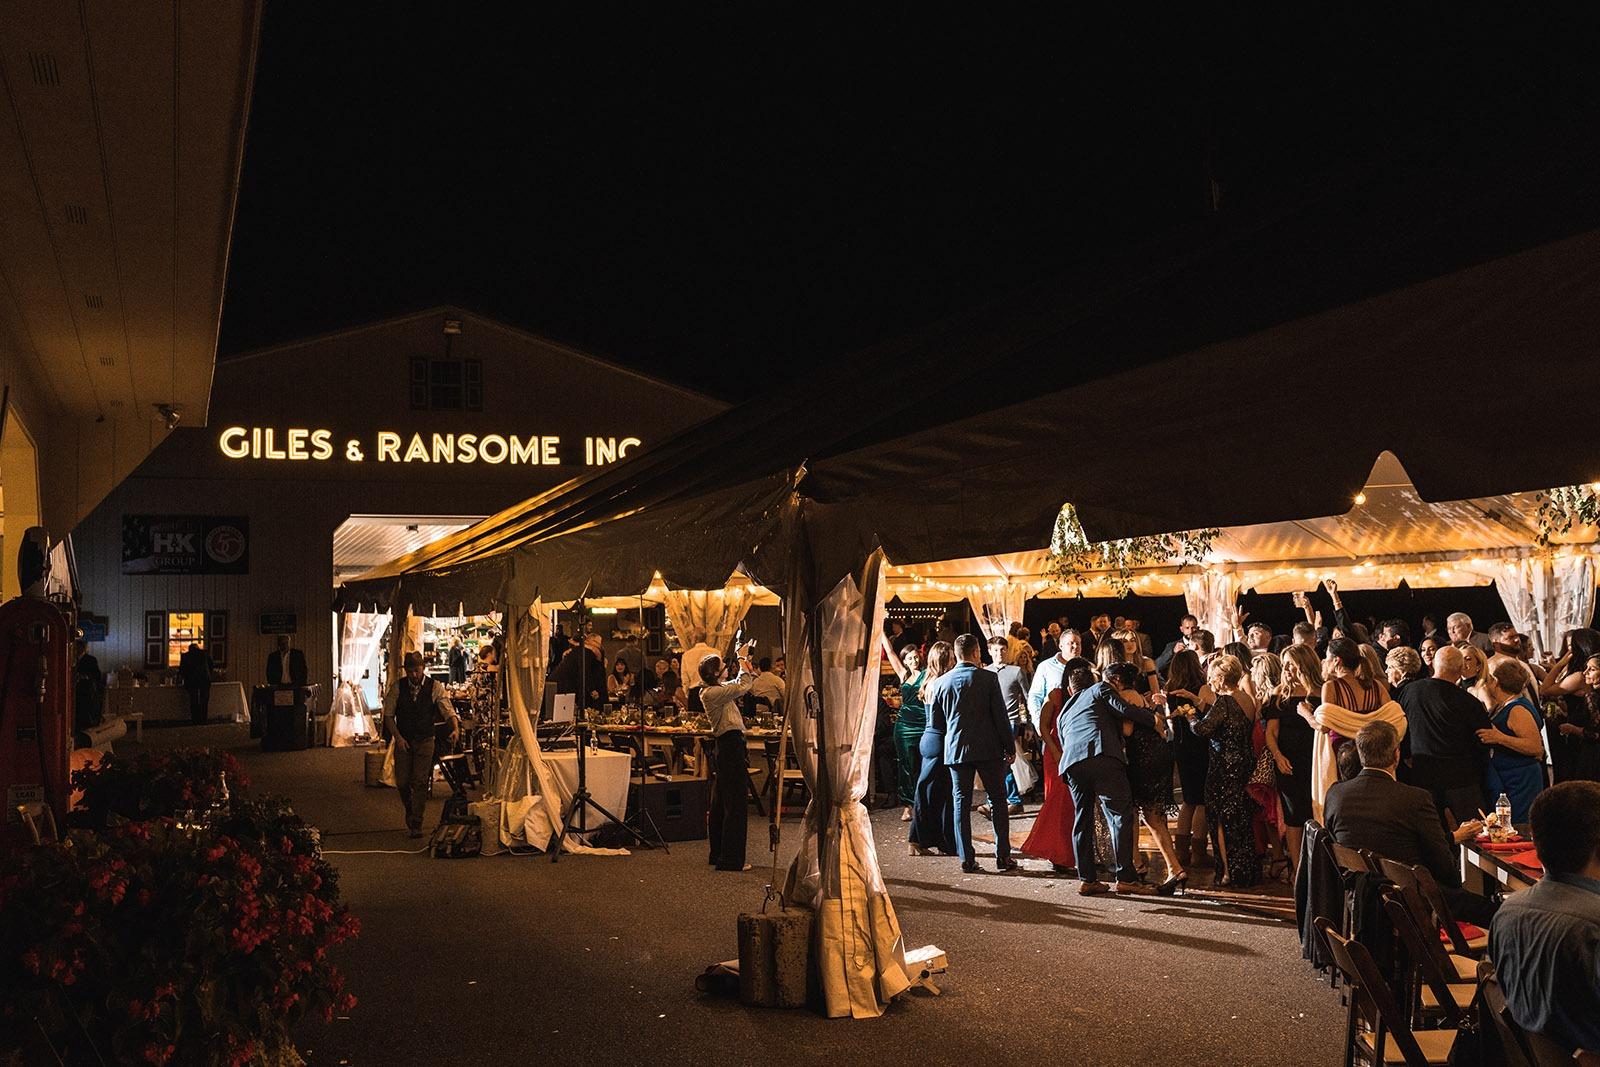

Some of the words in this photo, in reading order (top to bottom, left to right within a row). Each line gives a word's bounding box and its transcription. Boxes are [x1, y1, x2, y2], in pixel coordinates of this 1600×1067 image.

[219, 426, 333, 460] GILES
[345, 439, 365, 462] &
[377, 431, 561, 466] RANSOME
[155, 556, 195, 566] GROUP
